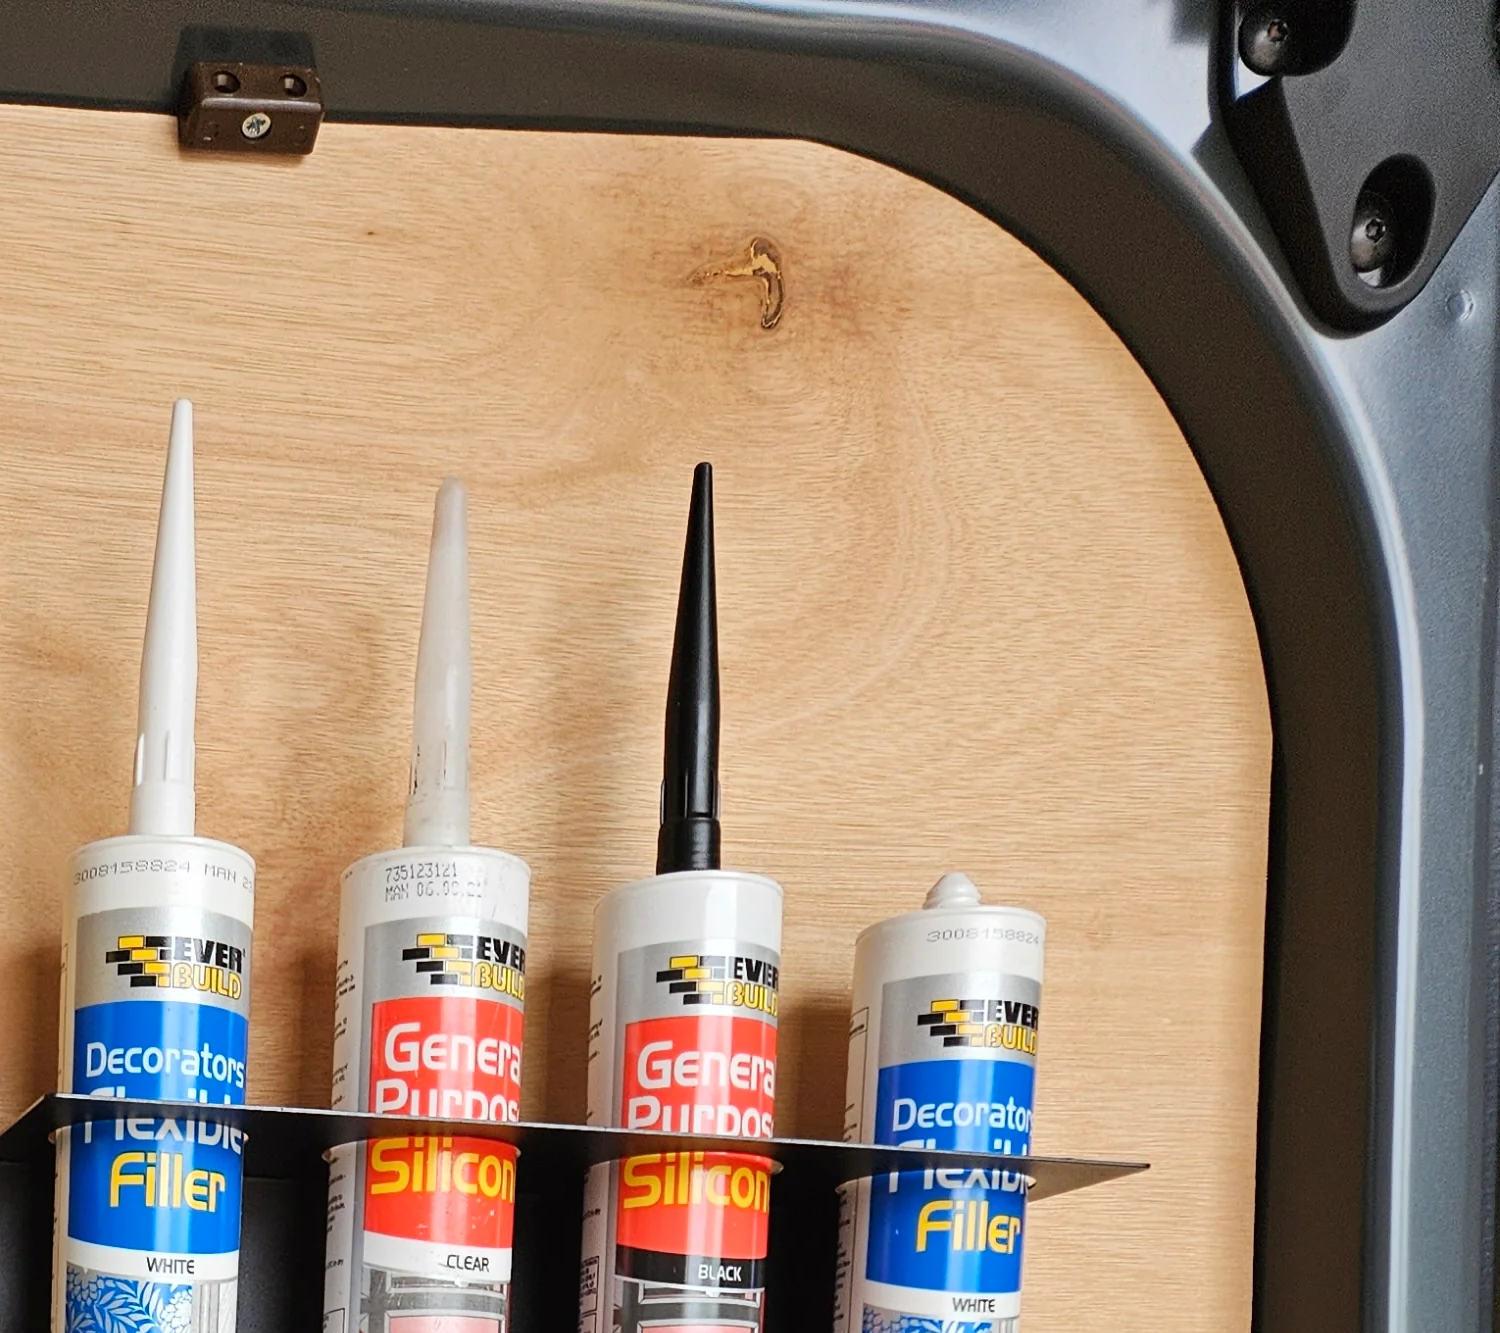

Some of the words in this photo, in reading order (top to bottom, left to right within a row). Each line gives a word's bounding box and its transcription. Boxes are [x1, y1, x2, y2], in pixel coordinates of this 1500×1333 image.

[204, 863, 237, 884] MAN
[385, 862, 458, 883] 735123121
[385, 883, 409, 902] MAN
[175, 935, 243, 973] EVER
[476, 936, 526, 976] EVER
[172, 964, 242, 999] BUILD
[728, 957, 779, 991] EVER
[988, 1000, 1039, 1030] EVER
[385, 1021, 521, 1088] Genera
[984, 1023, 1037, 1056] BUILD
[86, 1043, 244, 1088] Decorators
[637, 1040, 775, 1099] Genera
[375, 1078, 521, 1123] Purpos
[628, 1095, 775, 1138] Purpos
[893, 1096, 1032, 1136] Decorator
[109, 1151, 226, 1213] Filler
[371, 1136, 514, 1204] Silicon
[624, 1151, 769, 1213] Silicon
[916, 1199, 1021, 1254] Filler
[146, 1257, 195, 1275] WHITE
[446, 1254, 490, 1273] CLEAR
[698, 1263, 742, 1283] BLACK
[952, 1297, 995, 1314] WHITE
